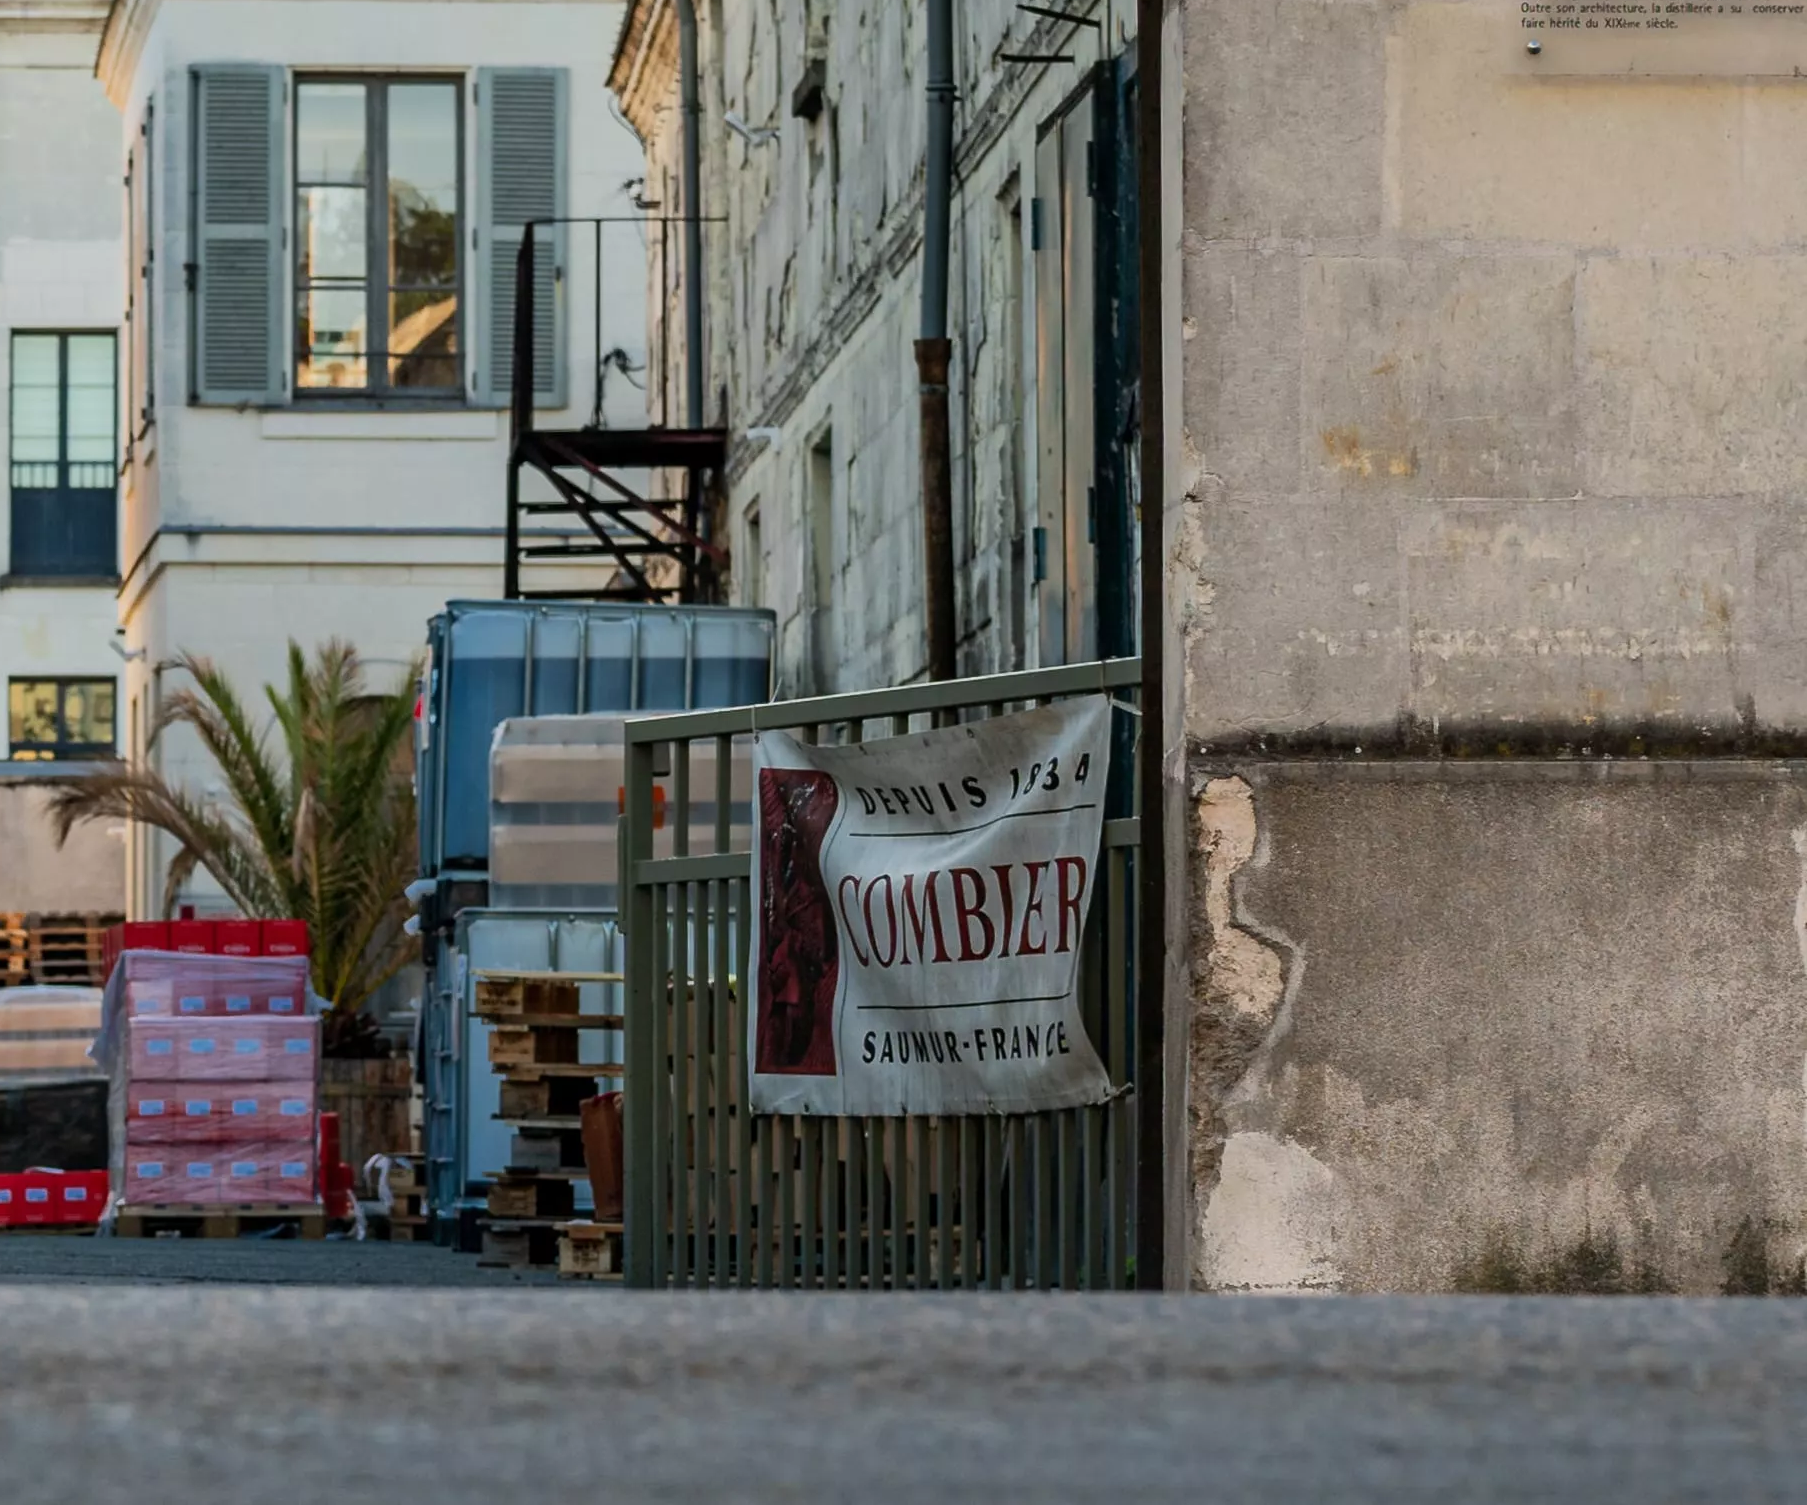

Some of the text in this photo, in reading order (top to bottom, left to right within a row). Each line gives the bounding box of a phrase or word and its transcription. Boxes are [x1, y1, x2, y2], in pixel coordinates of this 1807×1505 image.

[1521, 2, 1551, 13] Outre
[1556, 4, 1575, 13] son
[1580, 2, 1647, 15] architecture,
[1666, 2, 1713, 13] distillerie
[1753, 4, 1804, 13] conserver
[1521, 17, 1545, 29] faire
[1550, 17, 1581, 29] hérité
[1646, 17, 1678, 29] siècle.
[857, 752, 1091, 817] DEPUIS 1834
[838, 855, 1087, 968] COMBIER
[861, 1020, 1071, 1065] SAUMUR-FRANCE
